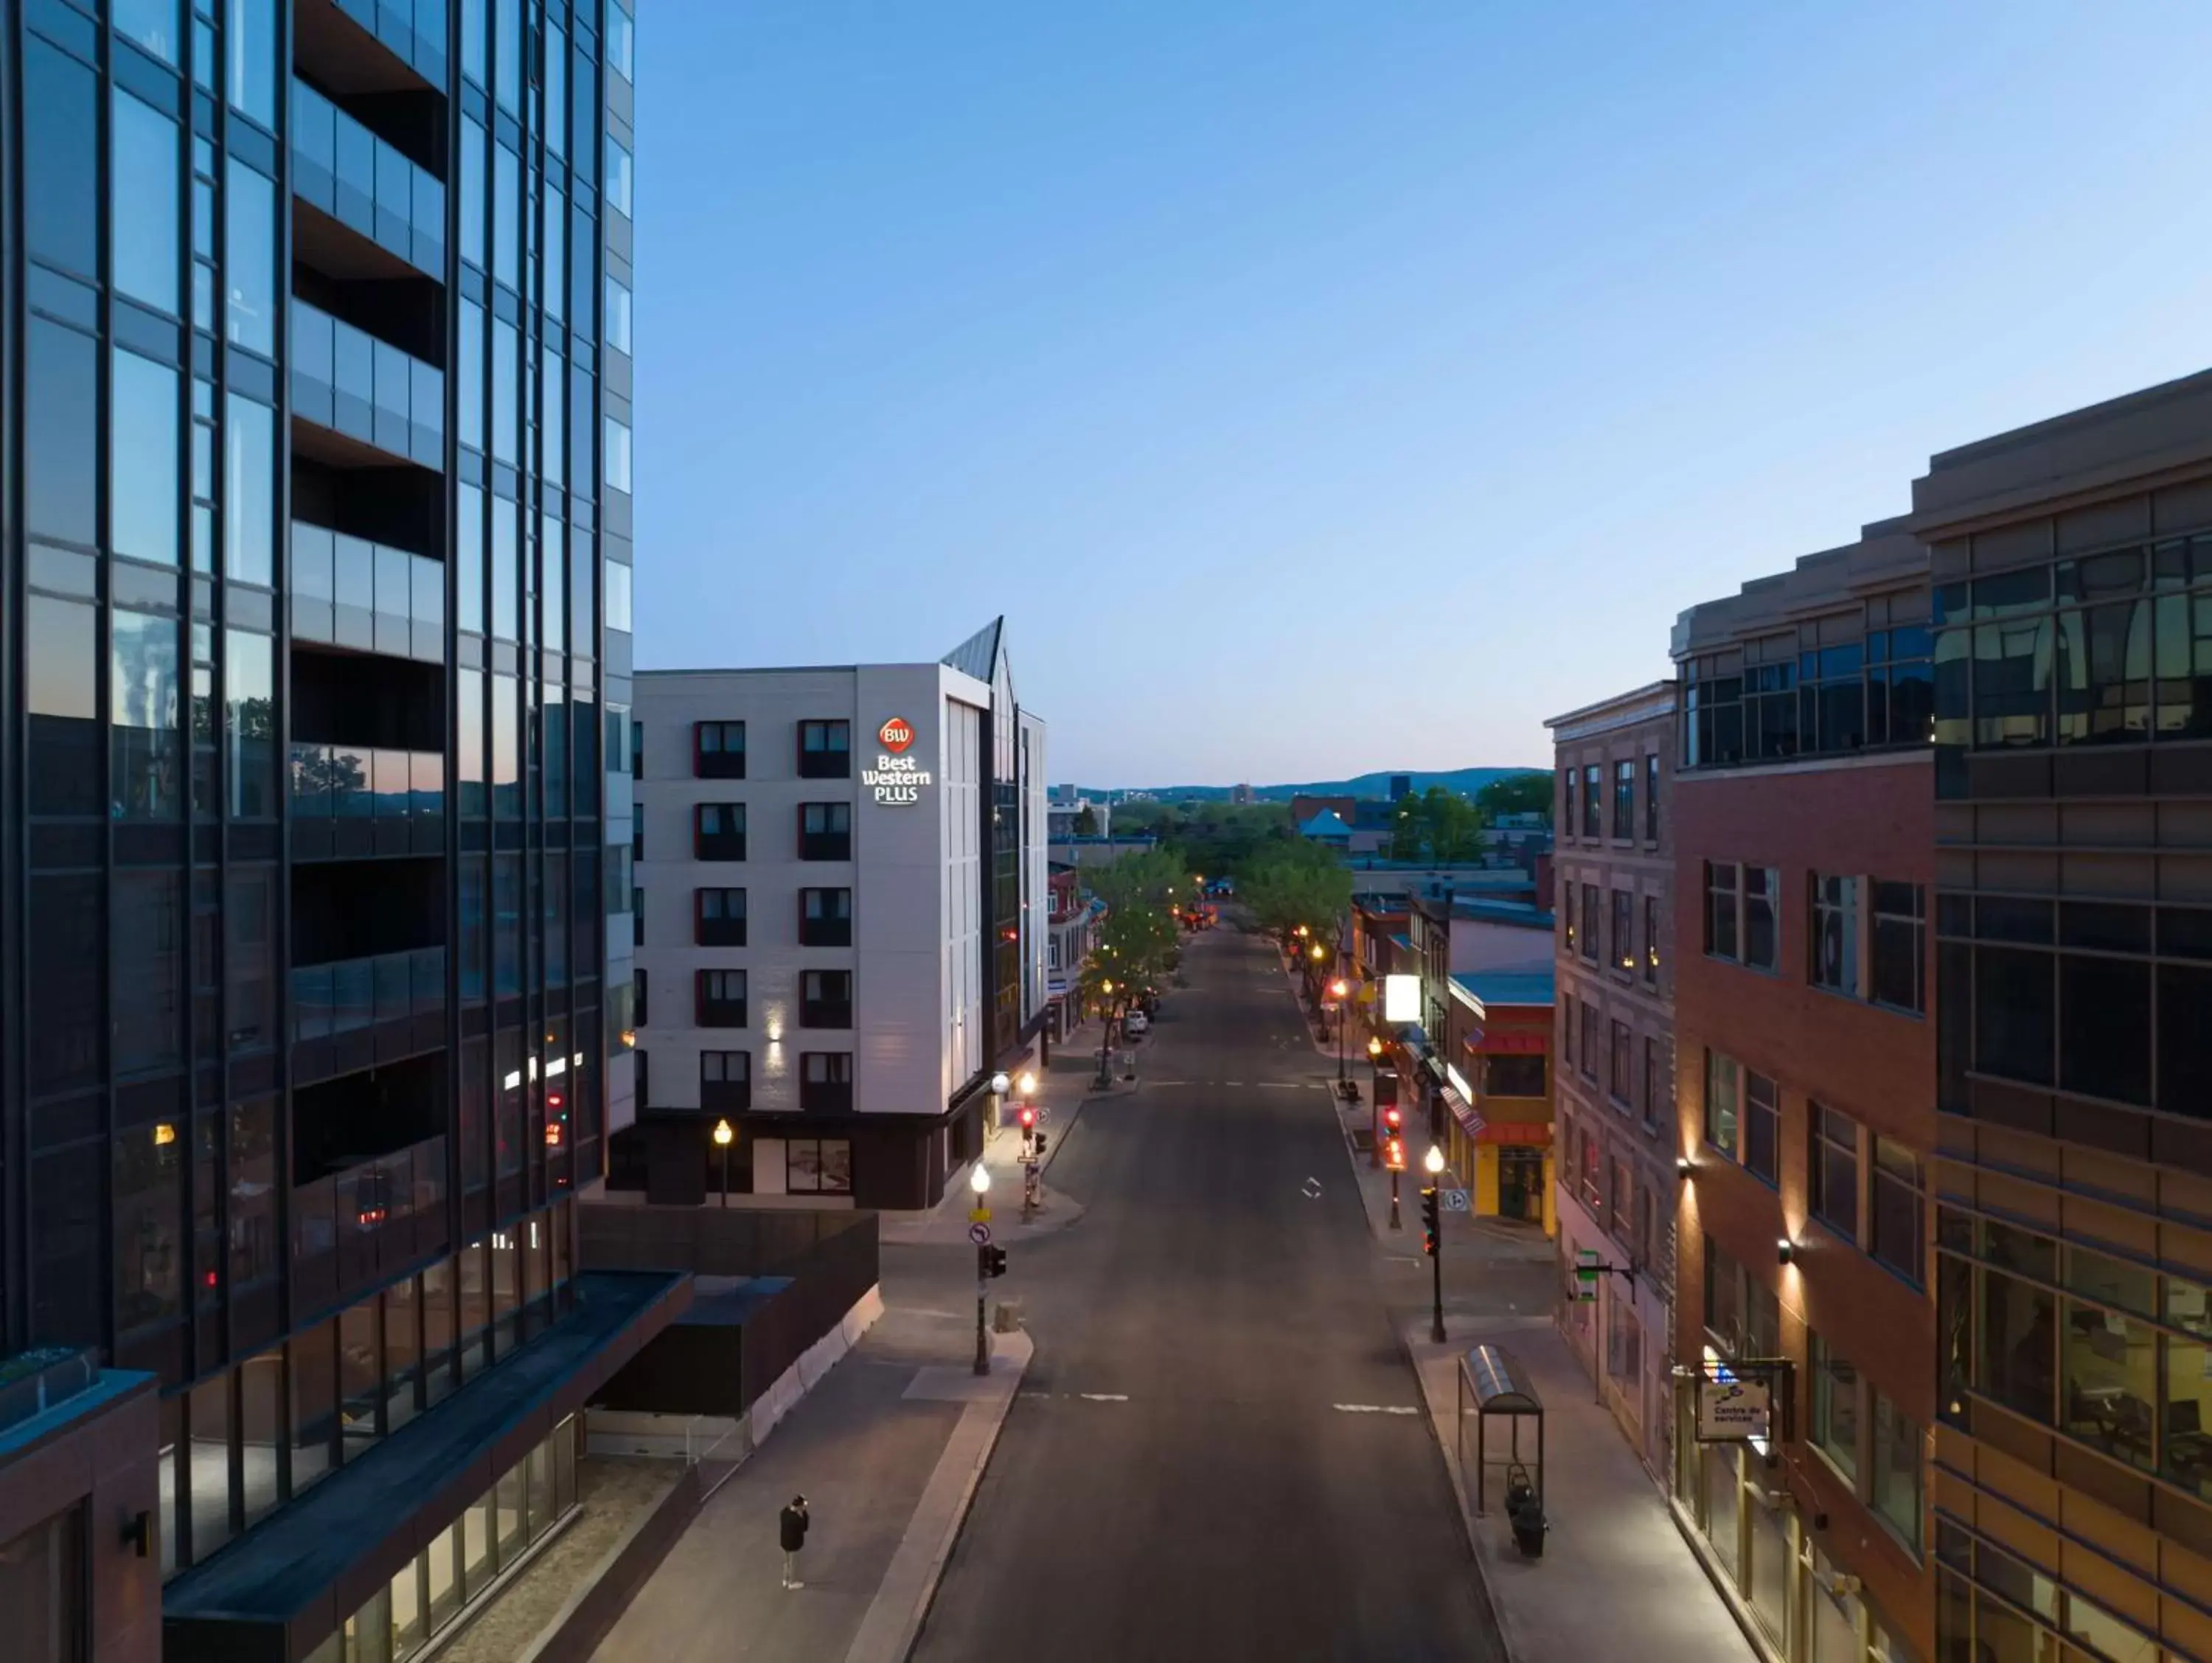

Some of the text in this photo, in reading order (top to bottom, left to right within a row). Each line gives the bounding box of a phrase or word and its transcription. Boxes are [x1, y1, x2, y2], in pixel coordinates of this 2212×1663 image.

[885, 728, 909, 742] BW
[878, 755, 916, 770] Best
[862, 770, 931, 785] Western
[874, 787, 918, 801] PLUS
